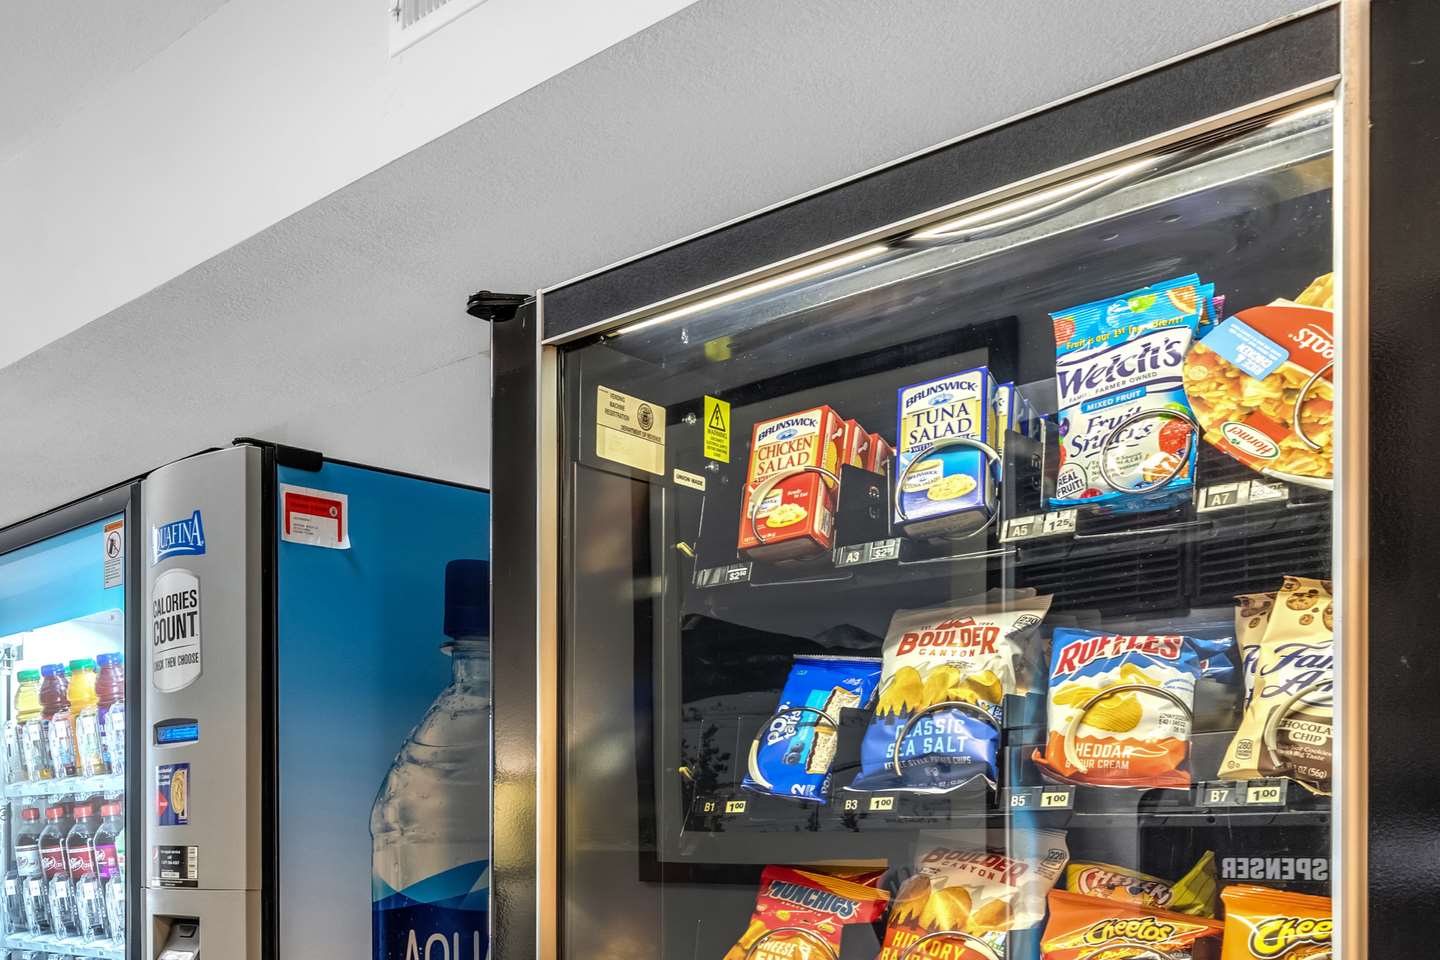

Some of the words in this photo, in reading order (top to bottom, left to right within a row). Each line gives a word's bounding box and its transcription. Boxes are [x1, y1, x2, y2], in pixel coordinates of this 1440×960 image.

[1057, 338, 1182, 399] Welch's
[1095, 380, 1126, 394] FARMER
[1129, 371, 1157, 384] OWNED
[906, 381, 977, 408] BRUNSWICK
[1087, 397, 1114, 411] MIXED
[1116, 390, 1141, 402] FRUIT
[912, 402, 969, 428] TUNA
[758, 417, 818, 441] BRUNSWICK
[910, 418, 972, 445] SALAD
[758, 435, 814, 460] CHICKEN
[1226, 426, 1274, 454] Hormel
[758, 452, 810, 476] SALAD
[1213, 493, 1230, 505] A7
[1013, 525, 1028, 537] A5
[846, 552, 860, 563] A3
[153, 589, 197, 618] CALORIES
[154, 612, 198, 646] COUNT
[896, 627, 1001, 657] BOULDER
[919, 648, 976, 657] CANYON
[165, 656, 176, 668] THEN
[177, 652, 199, 665] CHOOSE
[886, 740, 915, 758] SEA
[923, 736, 969, 753] SALT
[1293, 732, 1322, 743] CHIP
[1075, 743, 1132, 758] HEDDAR
[1097, 759, 1130, 770] CREAM
[704, 801, 715, 812] B1
[845, 799, 858, 810] B3
[1011, 795, 1025, 806] B5
[1211, 790, 1228, 802] B7
[921, 850, 1028, 887] BOULDER
[942, 861, 996, 880] CANYON
[1084, 916, 1175, 945] Cheetos
[757, 937, 797, 957] CHEESE
